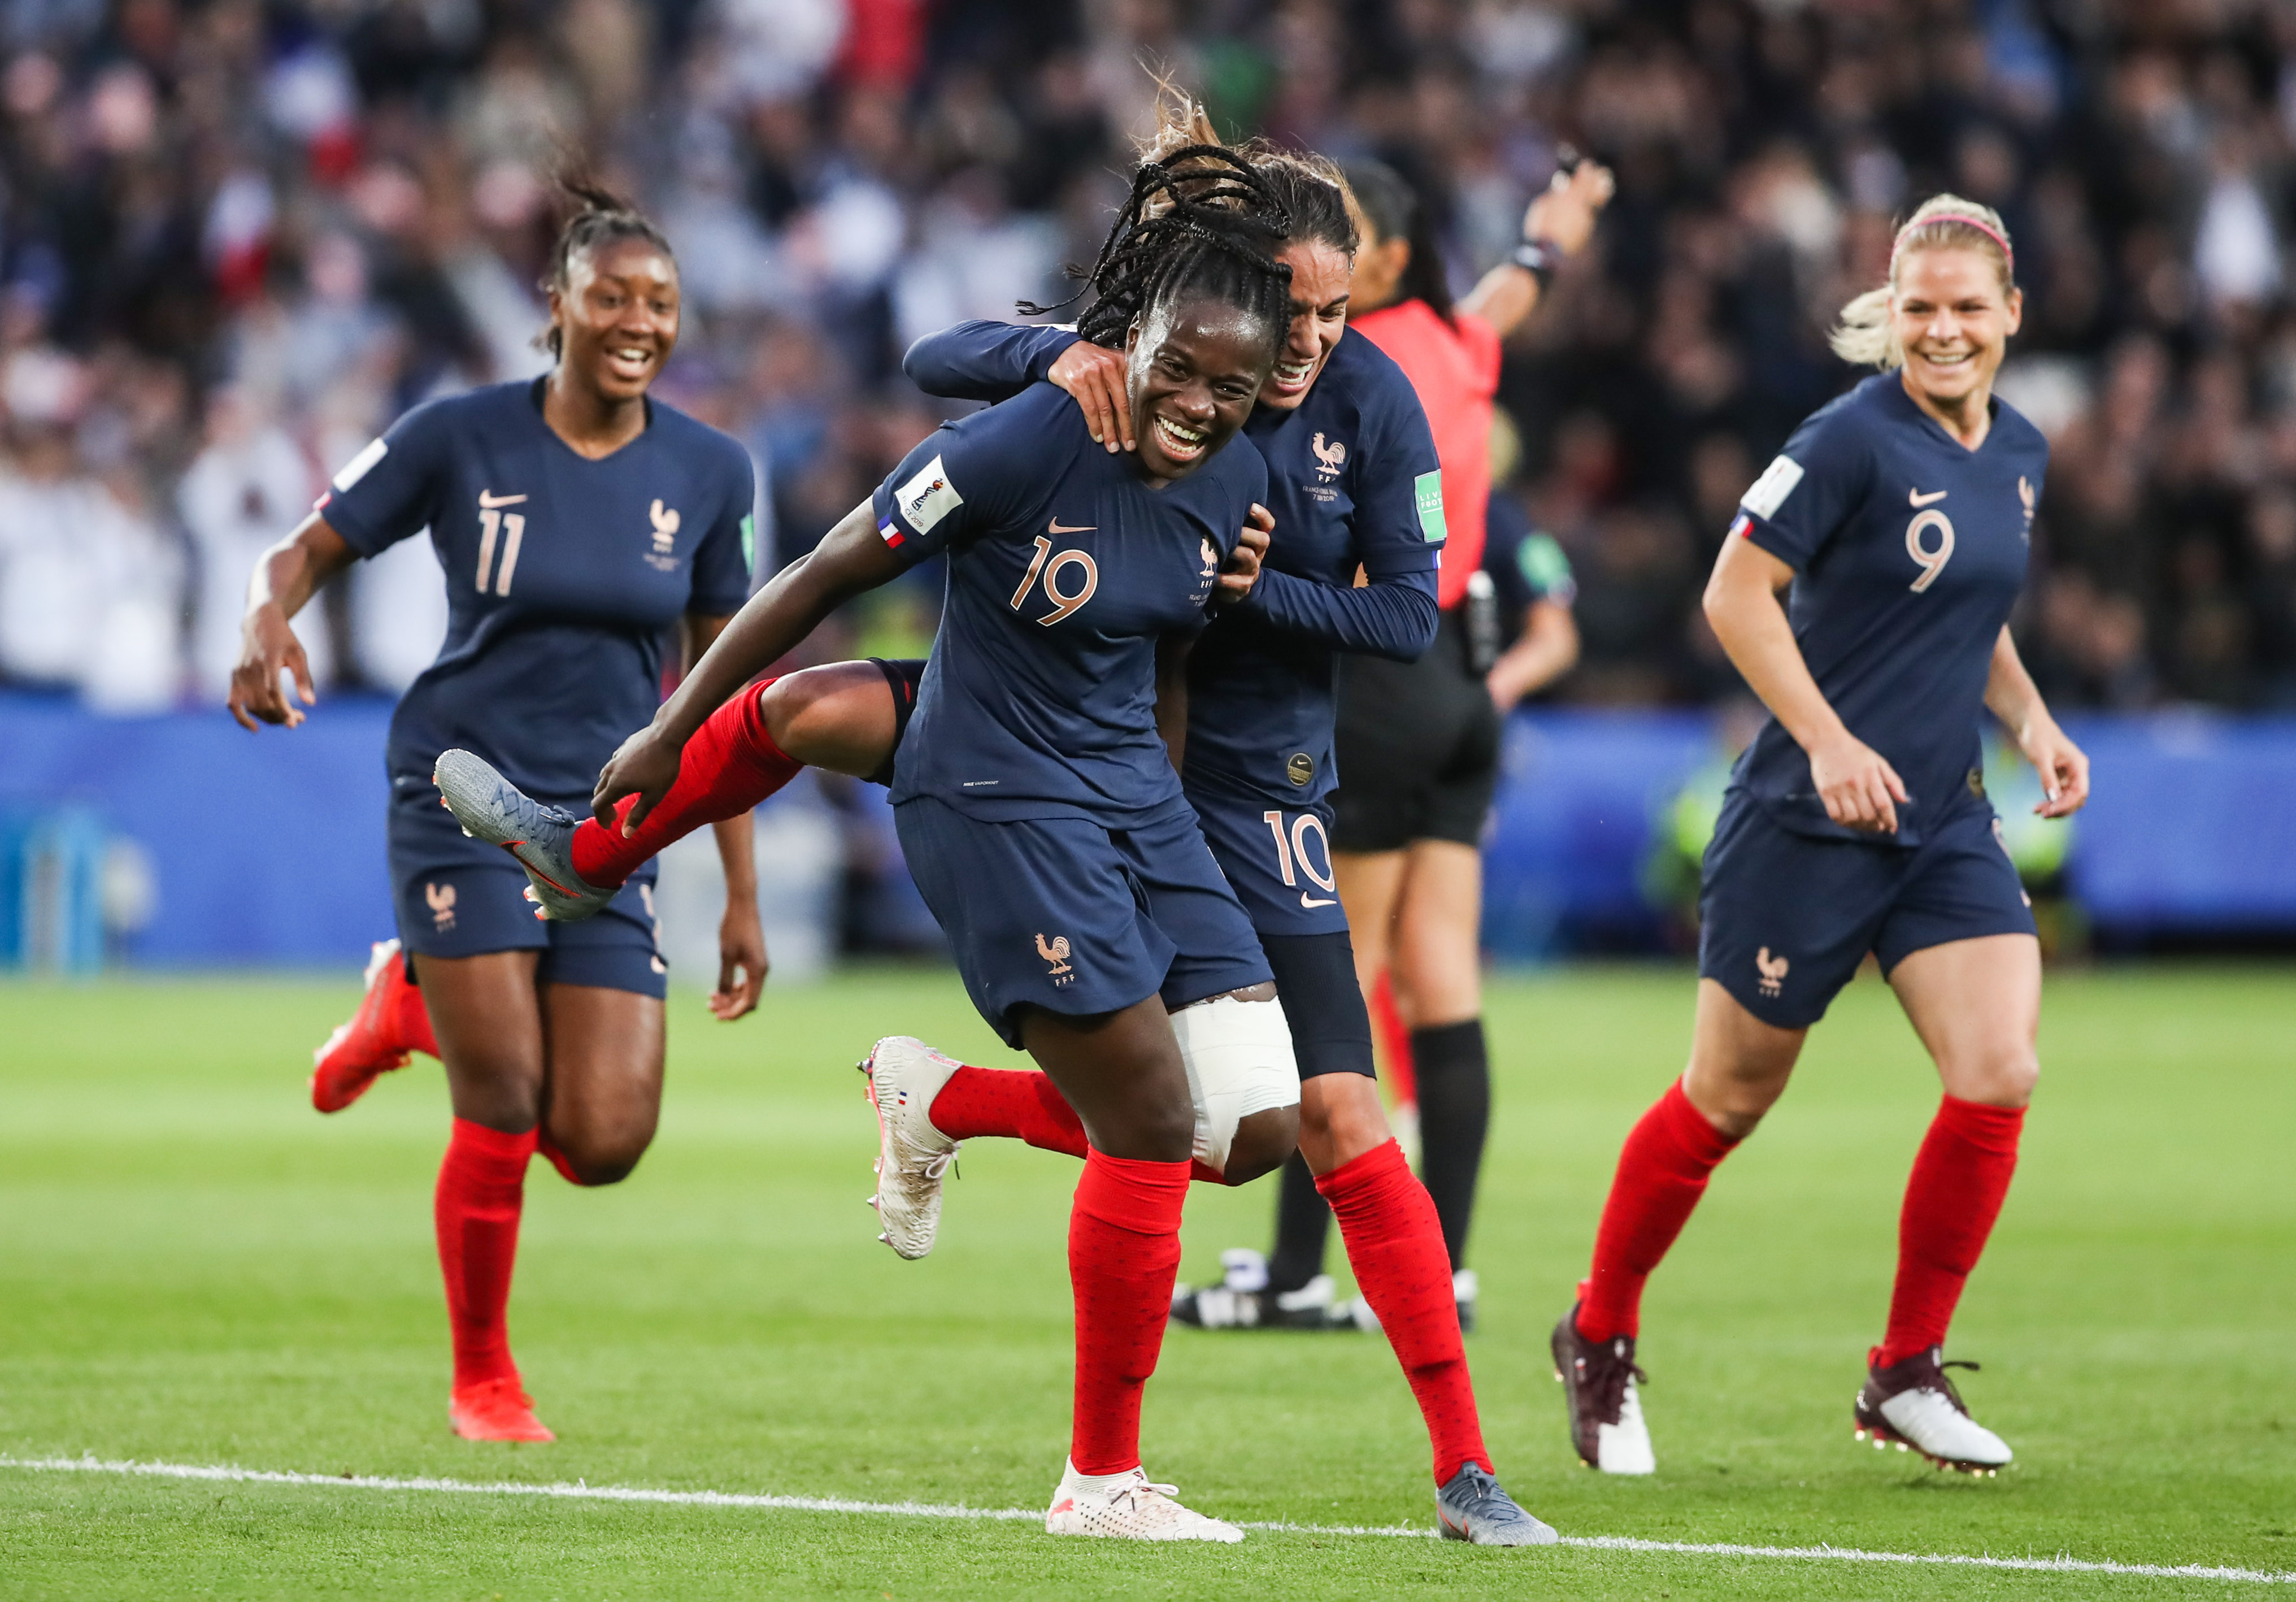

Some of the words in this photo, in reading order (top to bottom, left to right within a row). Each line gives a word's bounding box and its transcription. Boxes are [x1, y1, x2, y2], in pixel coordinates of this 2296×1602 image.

[1318, 474, 1336, 483] FF
[1420, 491, 1441, 501] LIV
[911, 516, 924, 527] 2019
[475, 509, 525, 597] 11
[1905, 509, 1955, 593] 9
[1010, 535, 1098, 627] 19
[1201, 580, 1213, 588] FFF
[1263, 810, 1336, 893] 10
[1055, 974, 1075, 987] FFF
